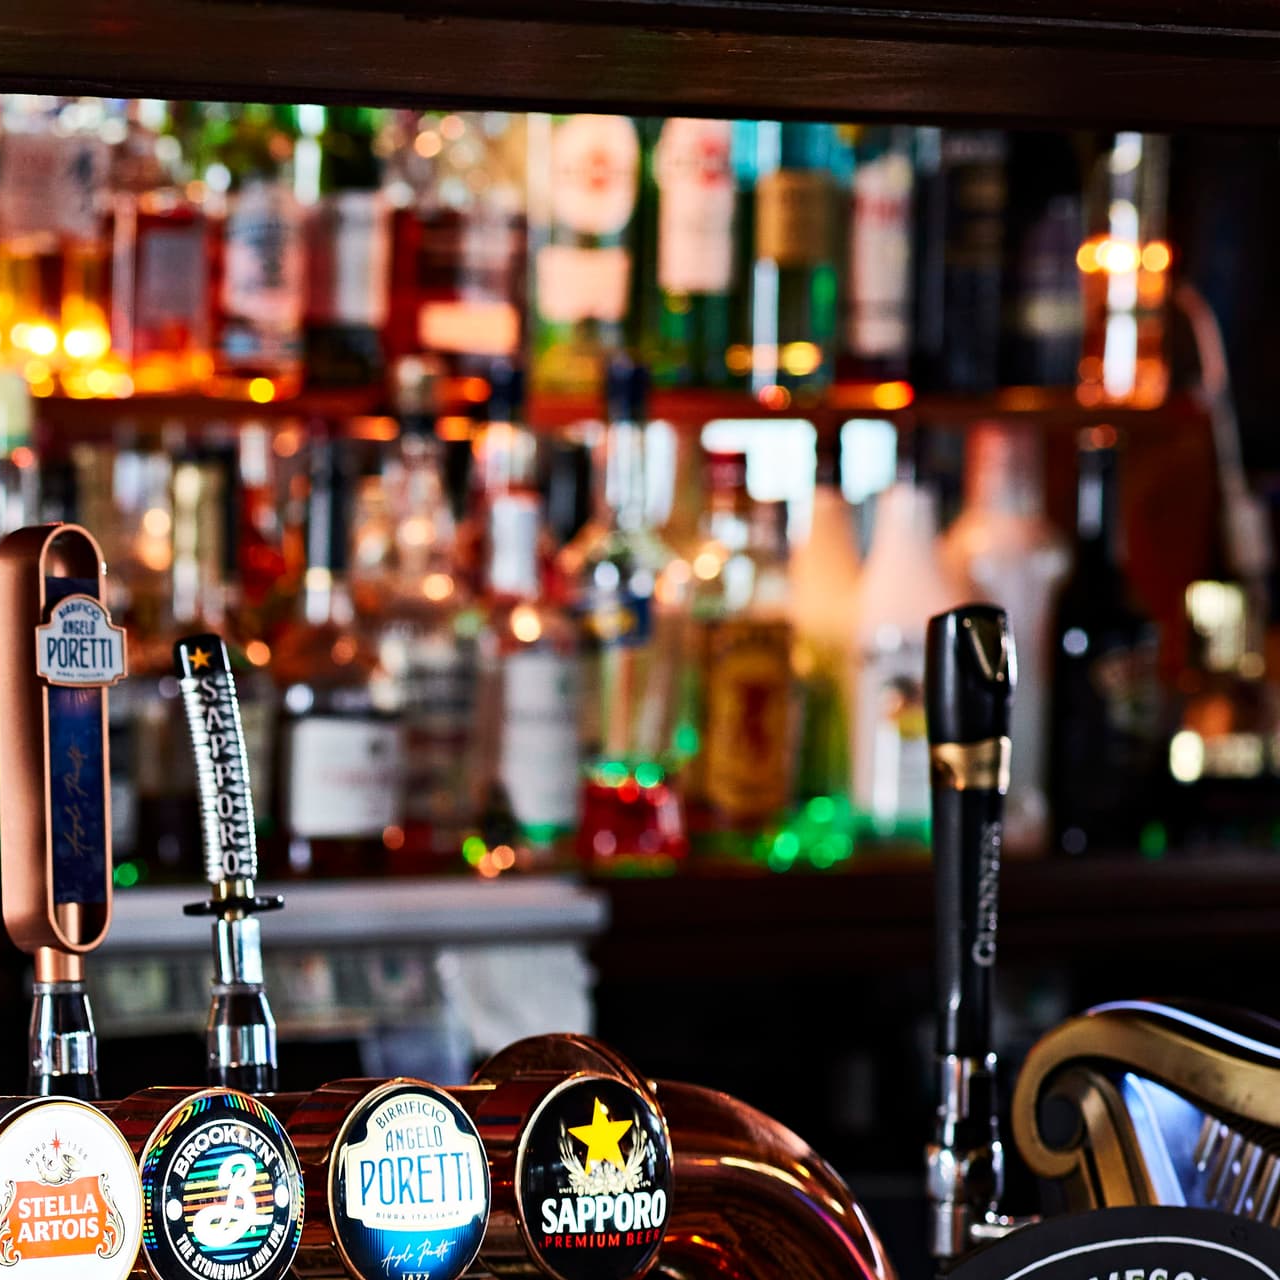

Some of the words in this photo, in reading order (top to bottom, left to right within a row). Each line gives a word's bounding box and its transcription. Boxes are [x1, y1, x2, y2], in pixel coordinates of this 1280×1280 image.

[62, 620, 97, 636] ANGELO
[46, 637, 113, 669] PORETTI
[200, 676, 240, 876] SAPPORO
[375, 1100, 447, 1130] BIRRIFICIO
[173, 1125, 276, 1180] BROOKLYN
[385, 1124, 444, 1152] ANGELO
[359, 1151, 473, 1206] PORETTI
[18, 1193, 100, 1219] STELLA
[541, 1188, 667, 1235] SAPPORO
[17, 1216, 100, 1243] ARTOIS
[545, 1232, 621, 1249] PREMIUM
[625, 1228, 661, 1247] BEER
[175, 1232, 194, 1261] THE
[253, 1241, 273, 1269] INN
[270, 1222, 287, 1250] IPA
